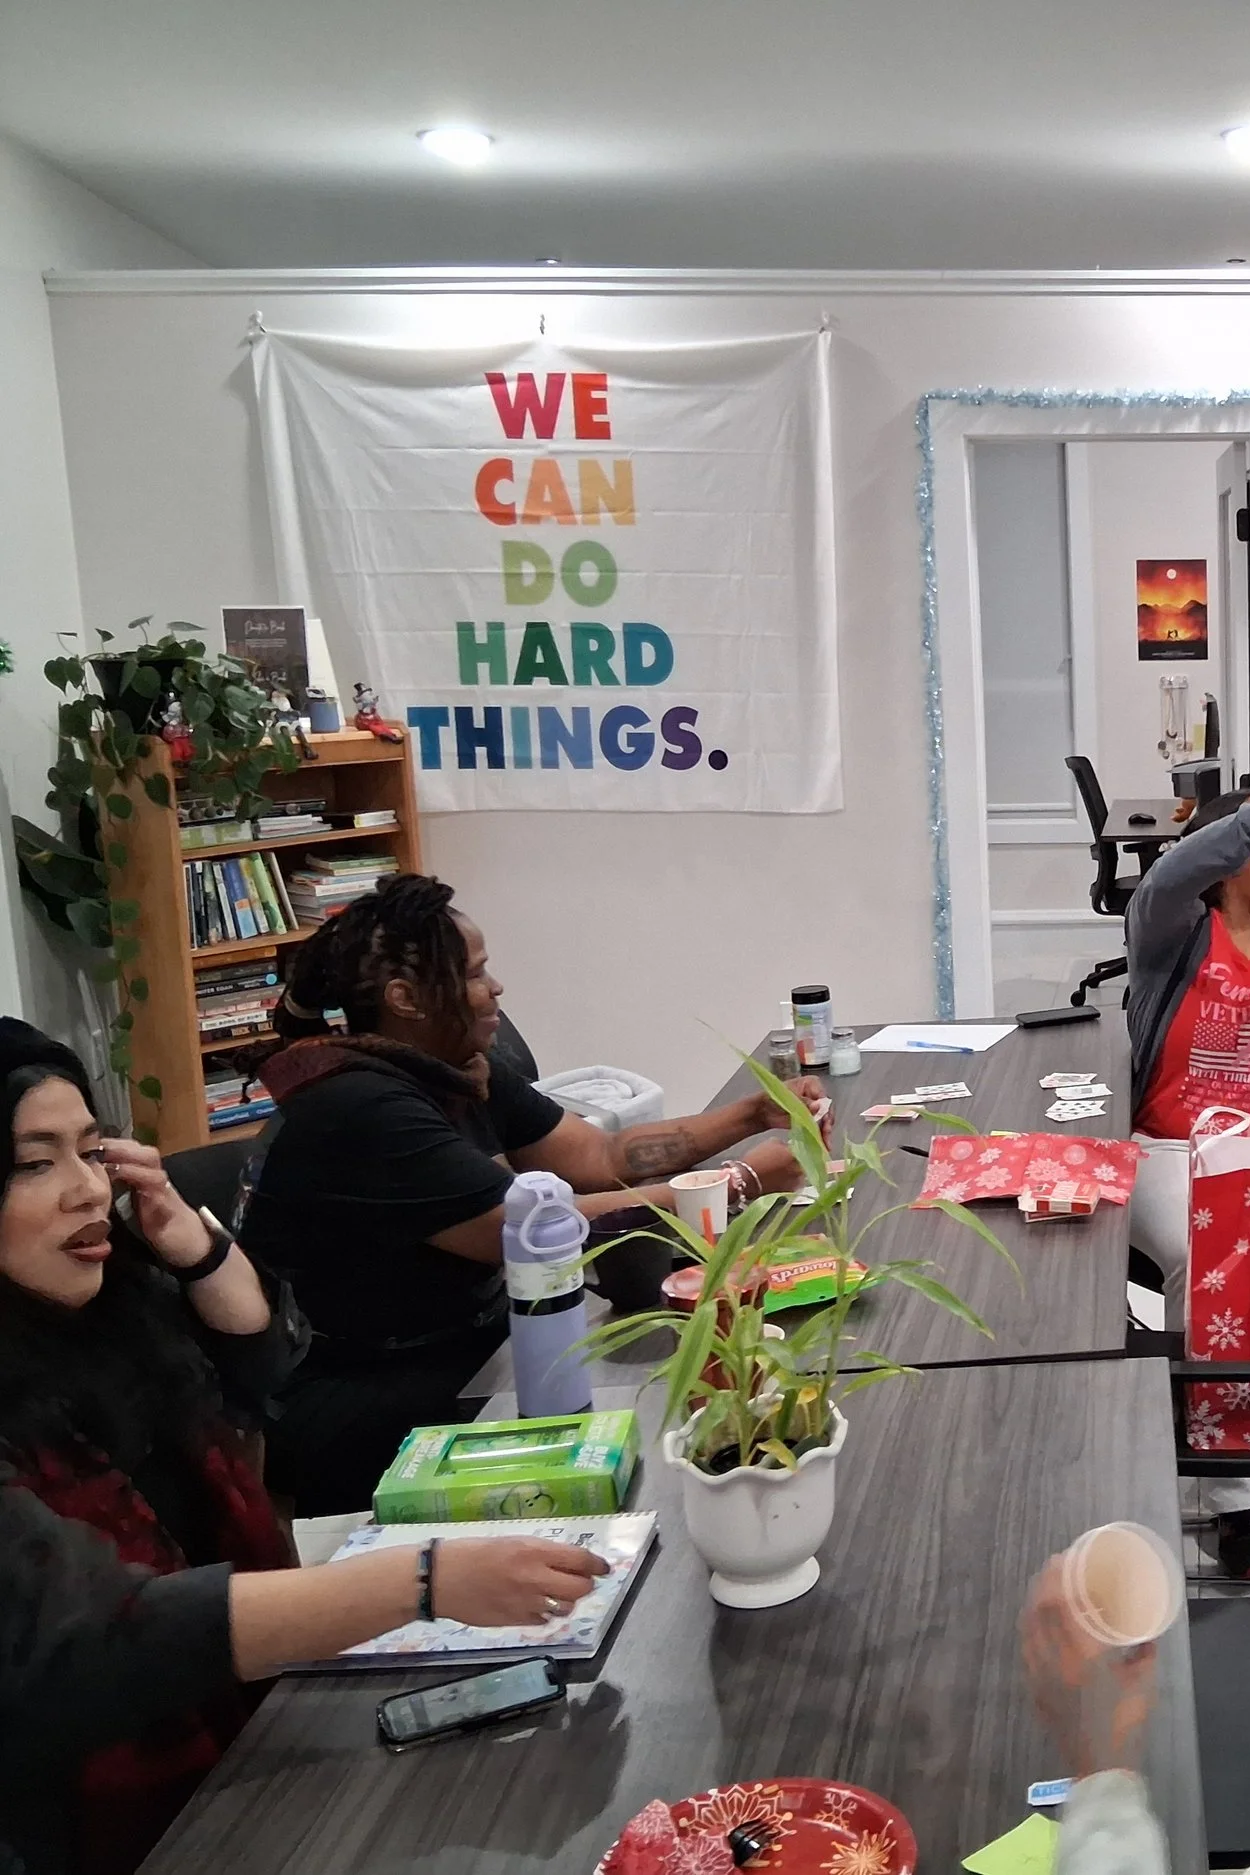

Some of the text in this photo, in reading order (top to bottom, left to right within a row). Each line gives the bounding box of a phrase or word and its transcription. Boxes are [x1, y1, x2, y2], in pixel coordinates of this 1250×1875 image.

[484, 372, 613, 441] WE
[474, 457, 637, 526] CAN
[501, 540, 619, 608] DO
[455, 621, 675, 687] HARD
[407, 705, 729, 771] THINGS.
[1188, 1066, 1219, 1080] WITH
